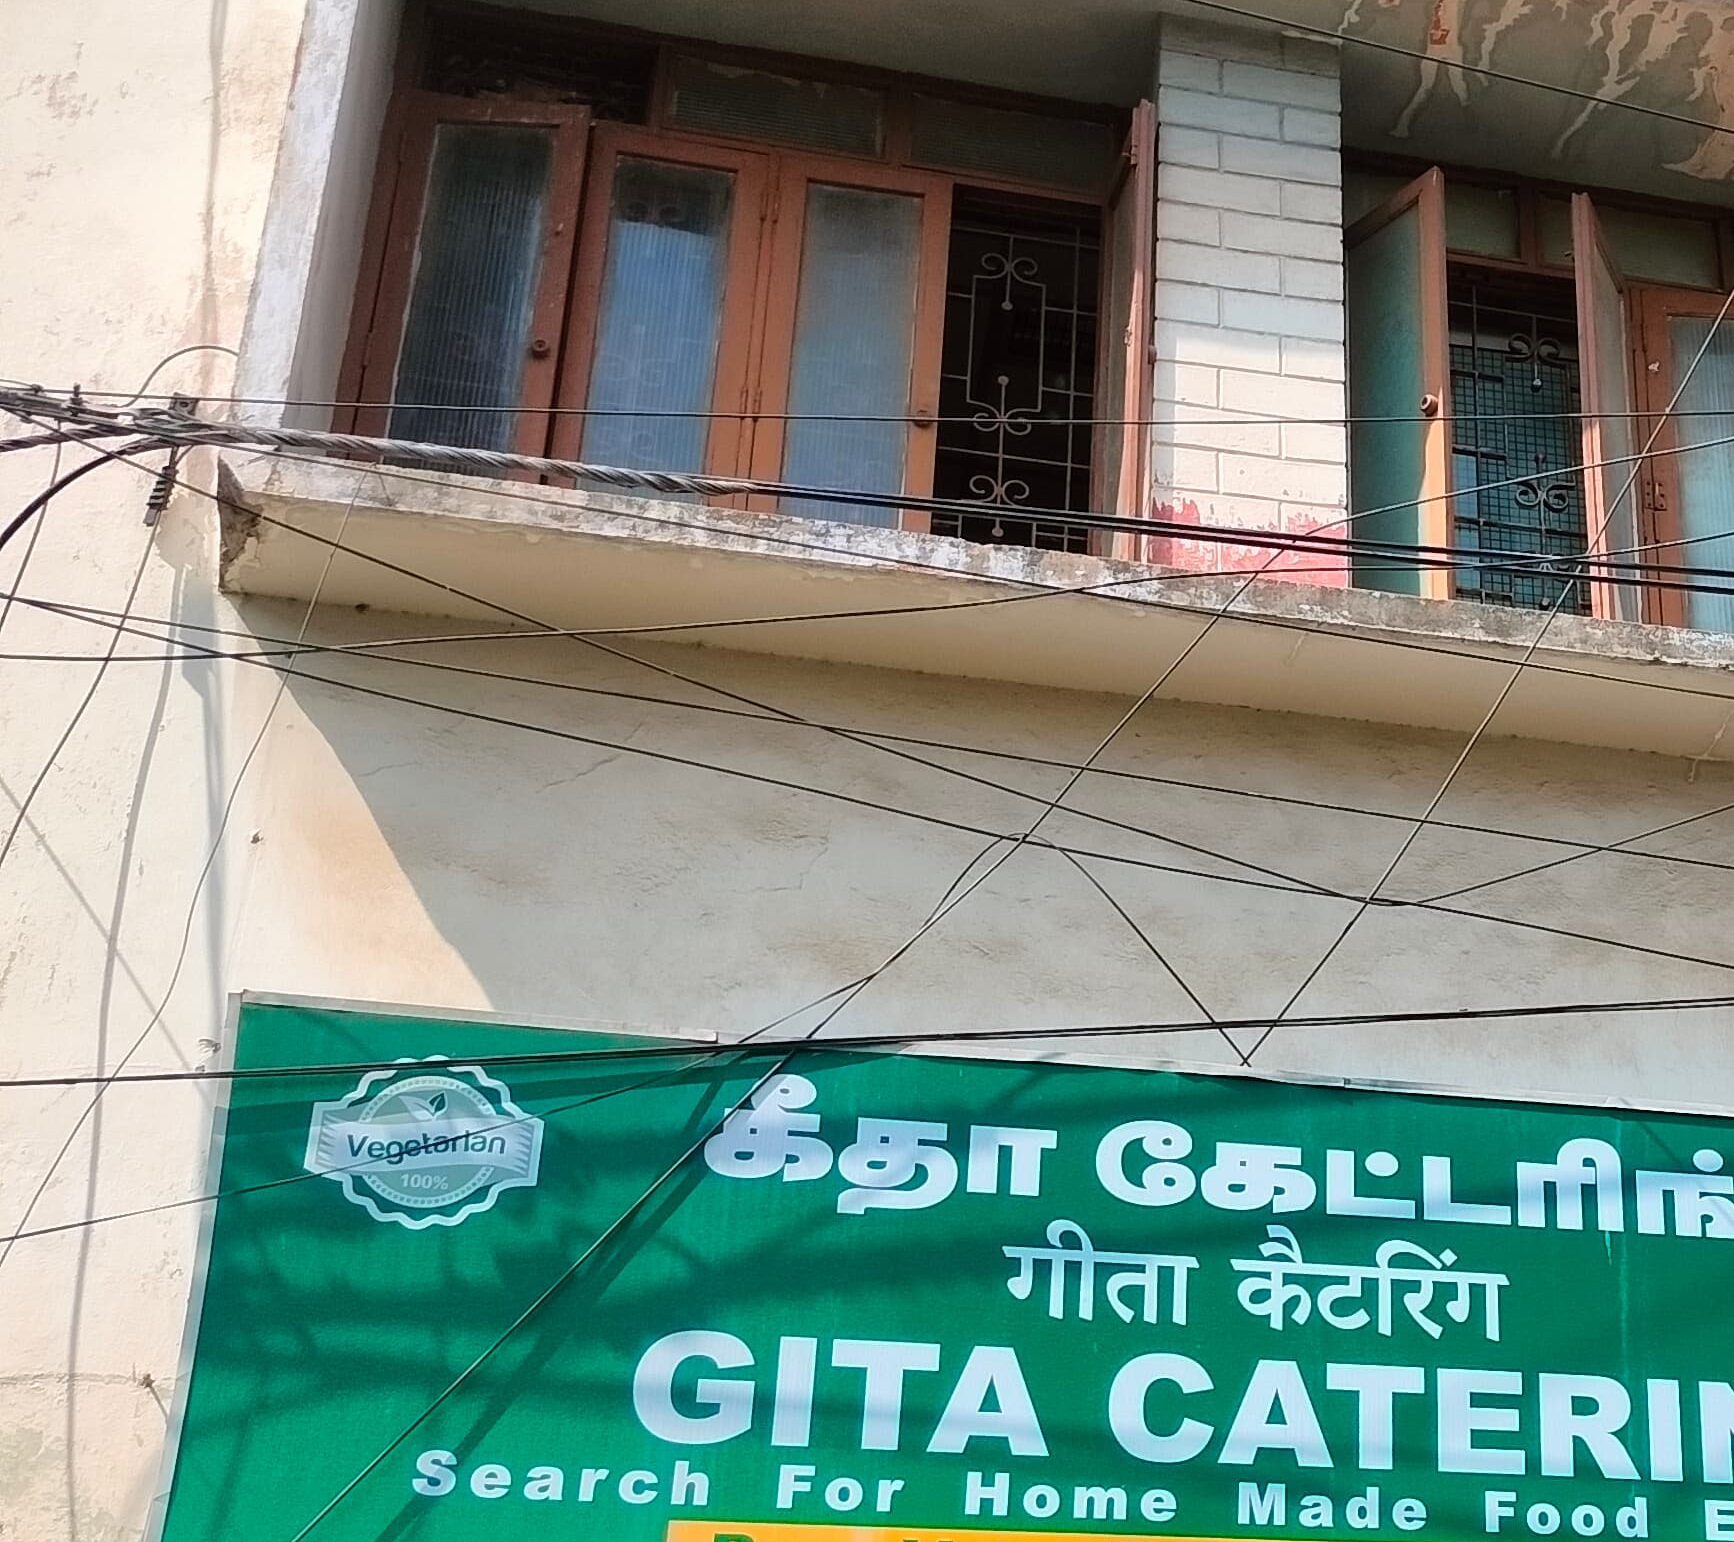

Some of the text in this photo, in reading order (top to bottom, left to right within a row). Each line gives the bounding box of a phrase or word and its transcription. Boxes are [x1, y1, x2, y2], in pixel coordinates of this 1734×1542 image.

[346, 1128, 507, 1166] Vegetarian
[400, 1173, 450, 1191] 100%
[704, 1073, 1058, 1215] கீதா
[1002, 1219, 1510, 1342] गीता कैटरिंग
[633, 1330, 1049, 1457] GITA
[412, 1449, 709, 1506] Search
[776, 1464, 905, 1512] For
[964, 1471, 1177, 1522] Home
[1237, 1481, 1427, 1531] Made
[1484, 1490, 1649, 1538] Food
